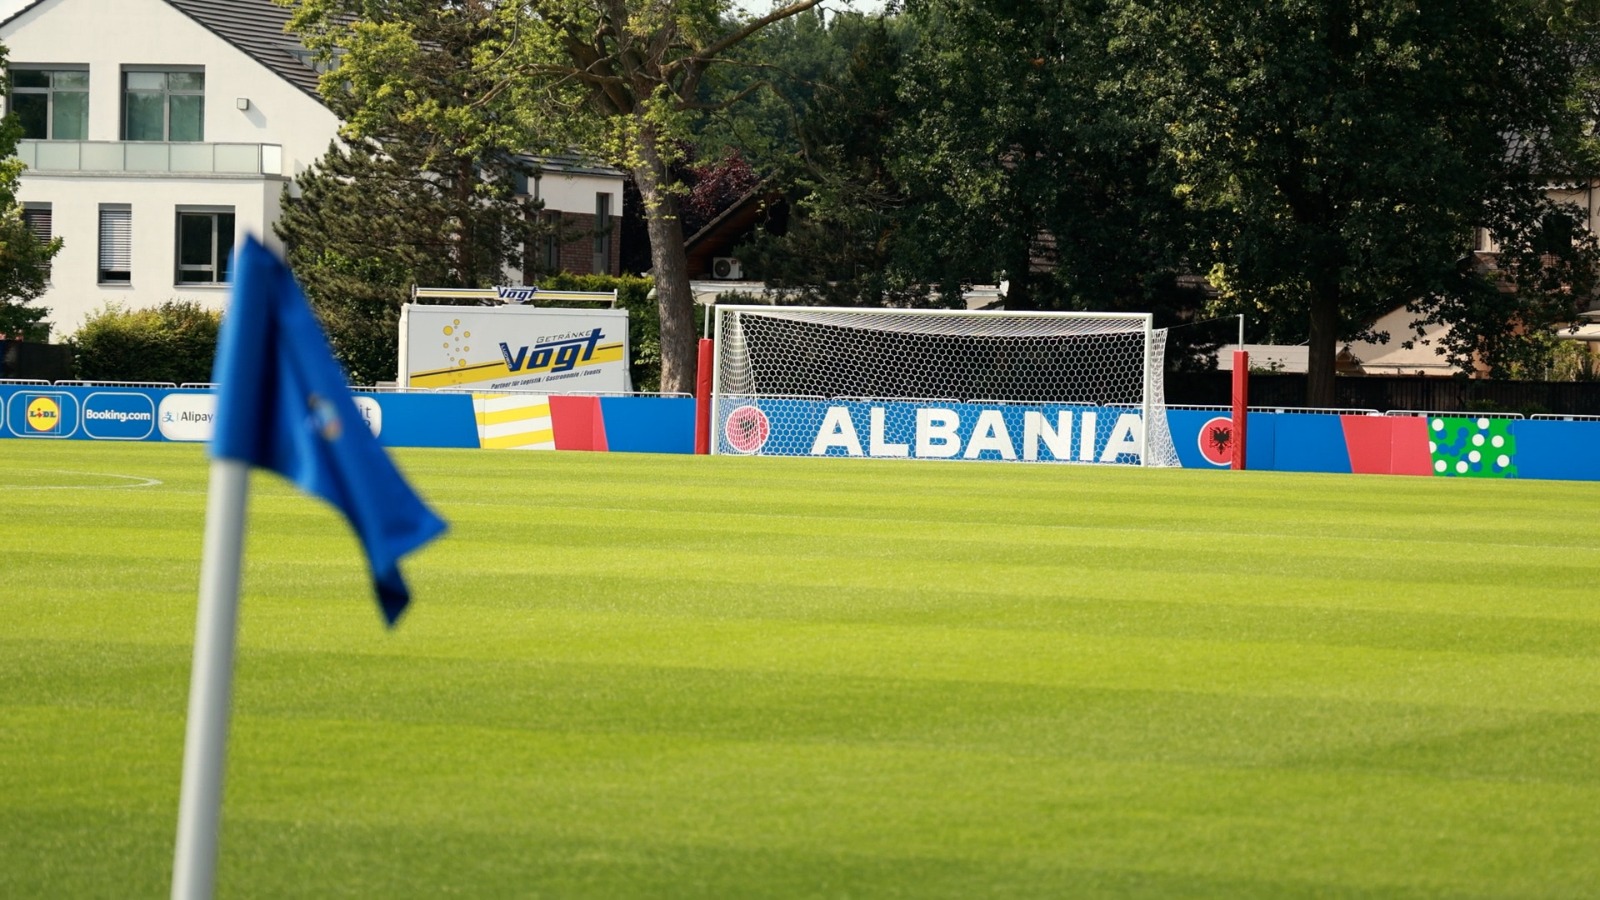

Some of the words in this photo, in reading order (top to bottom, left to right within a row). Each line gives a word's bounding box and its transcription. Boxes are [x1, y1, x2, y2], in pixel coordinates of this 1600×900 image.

[497, 286, 538, 301] Vogt
[536, 330, 592, 344] GETRÄNKE
[499, 327, 605, 373] Vogt
[546, 372, 579, 382] Gastronomie
[86, 404, 151, 423] Booking.com
[180, 411, 214, 423] Alipay
[810, 406, 1143, 461] ALBANIA
